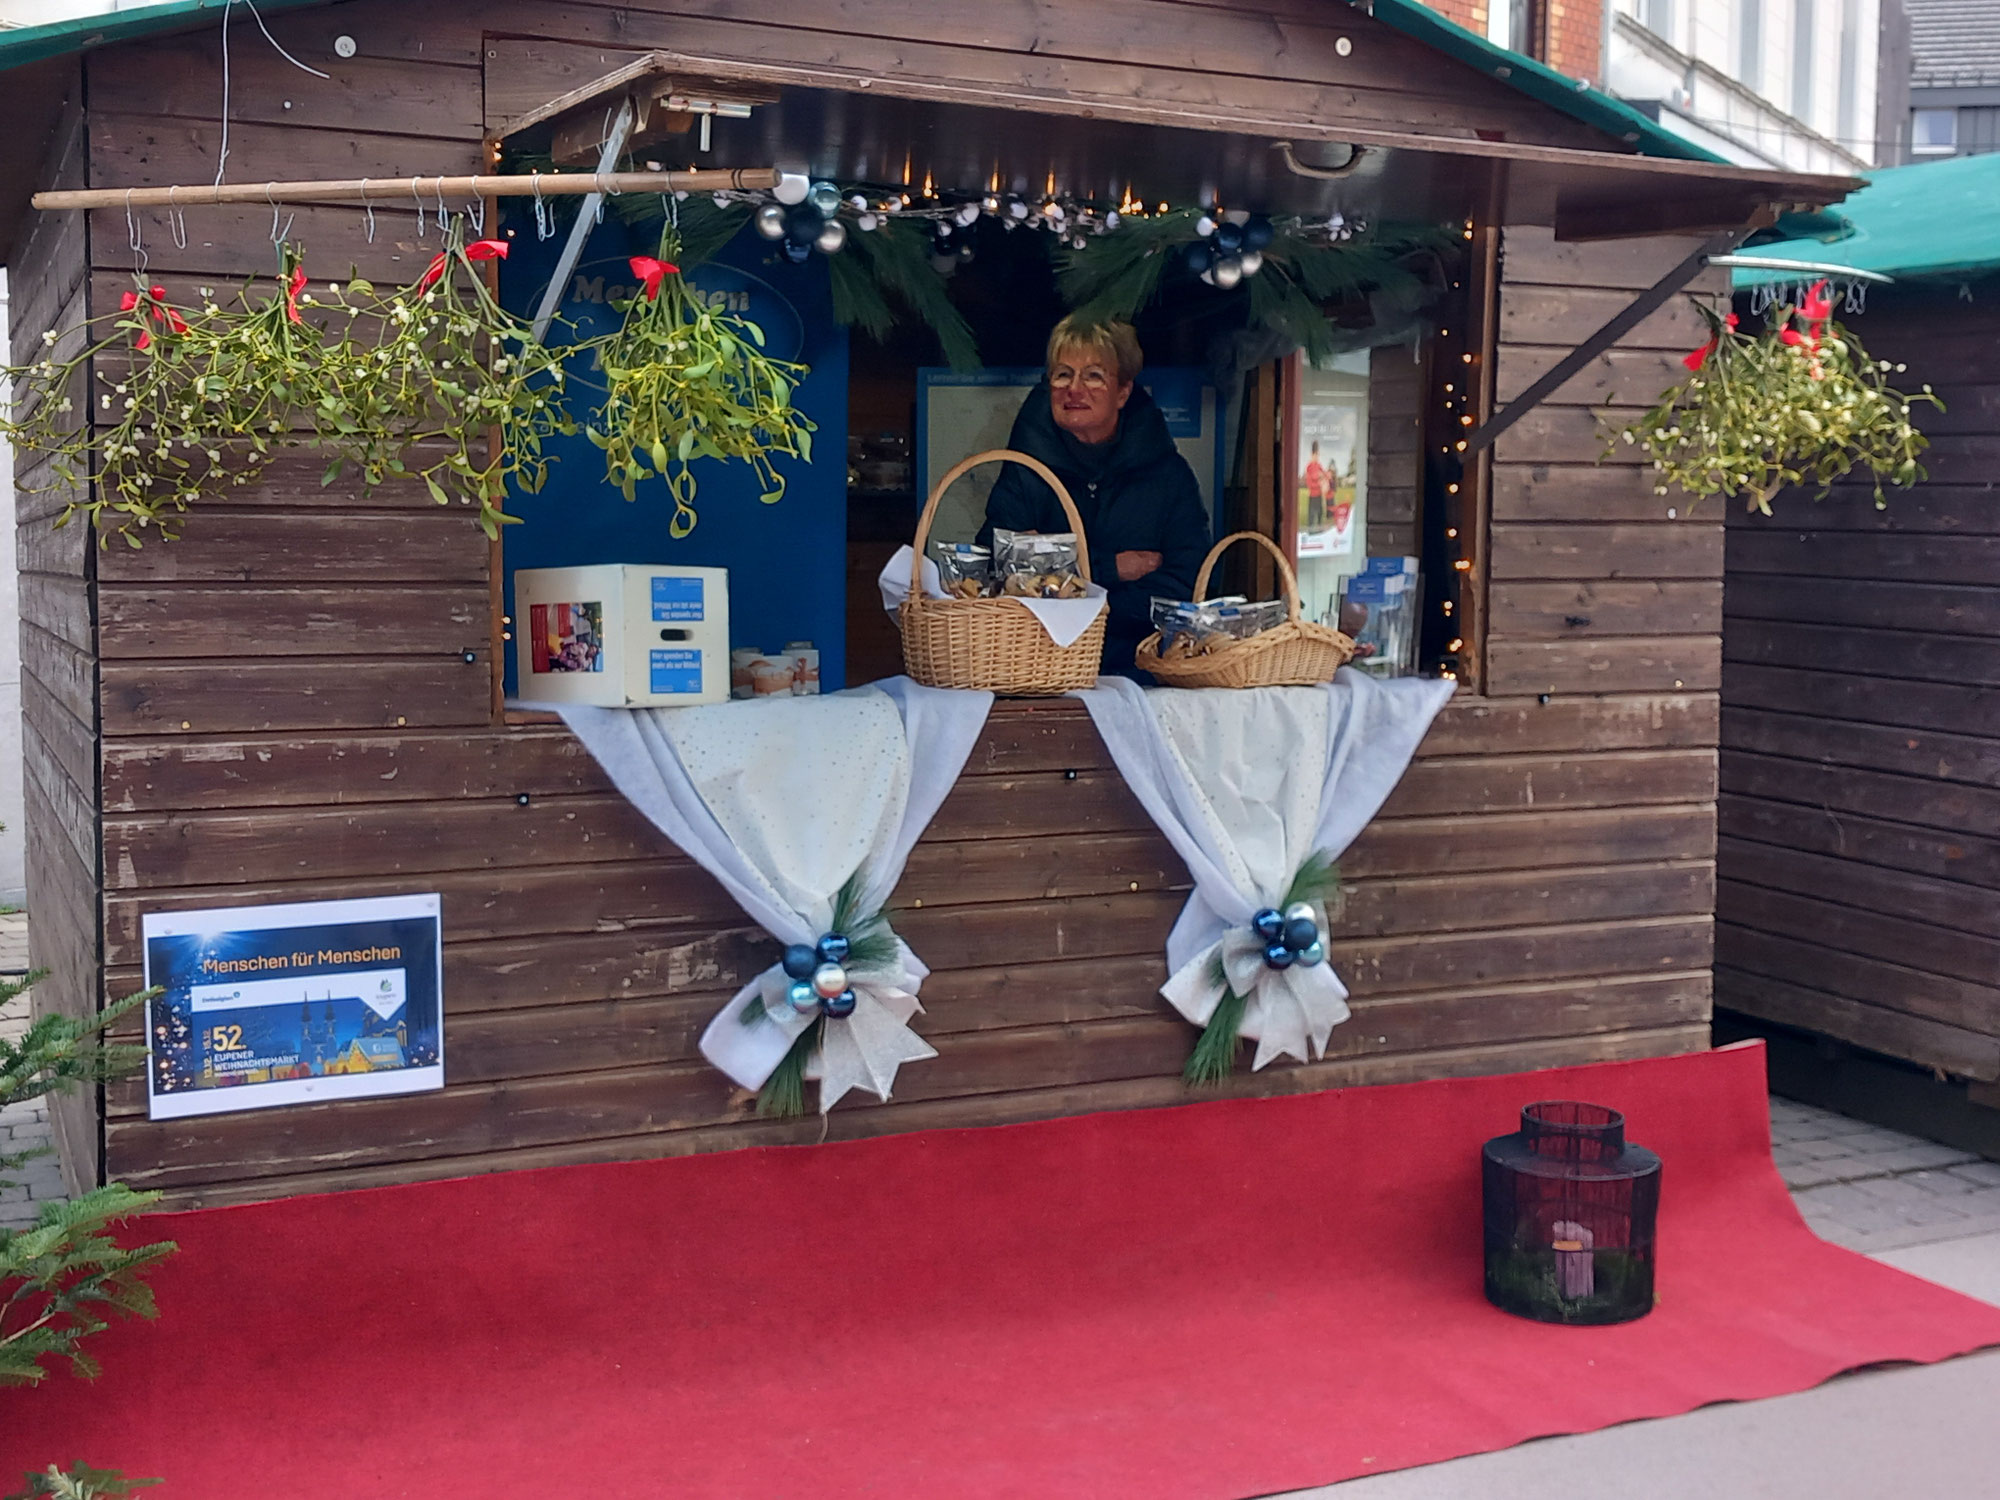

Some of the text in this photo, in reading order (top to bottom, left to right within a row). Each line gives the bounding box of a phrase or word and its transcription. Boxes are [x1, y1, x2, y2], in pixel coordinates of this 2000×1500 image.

[203, 946, 401, 975] Menschen für Menschen
[213, 1024, 247, 1052] 52.
[214, 1050, 254, 1063] EUPENER
[214, 1054, 300, 1072] WEIHNACHTSMARKT
